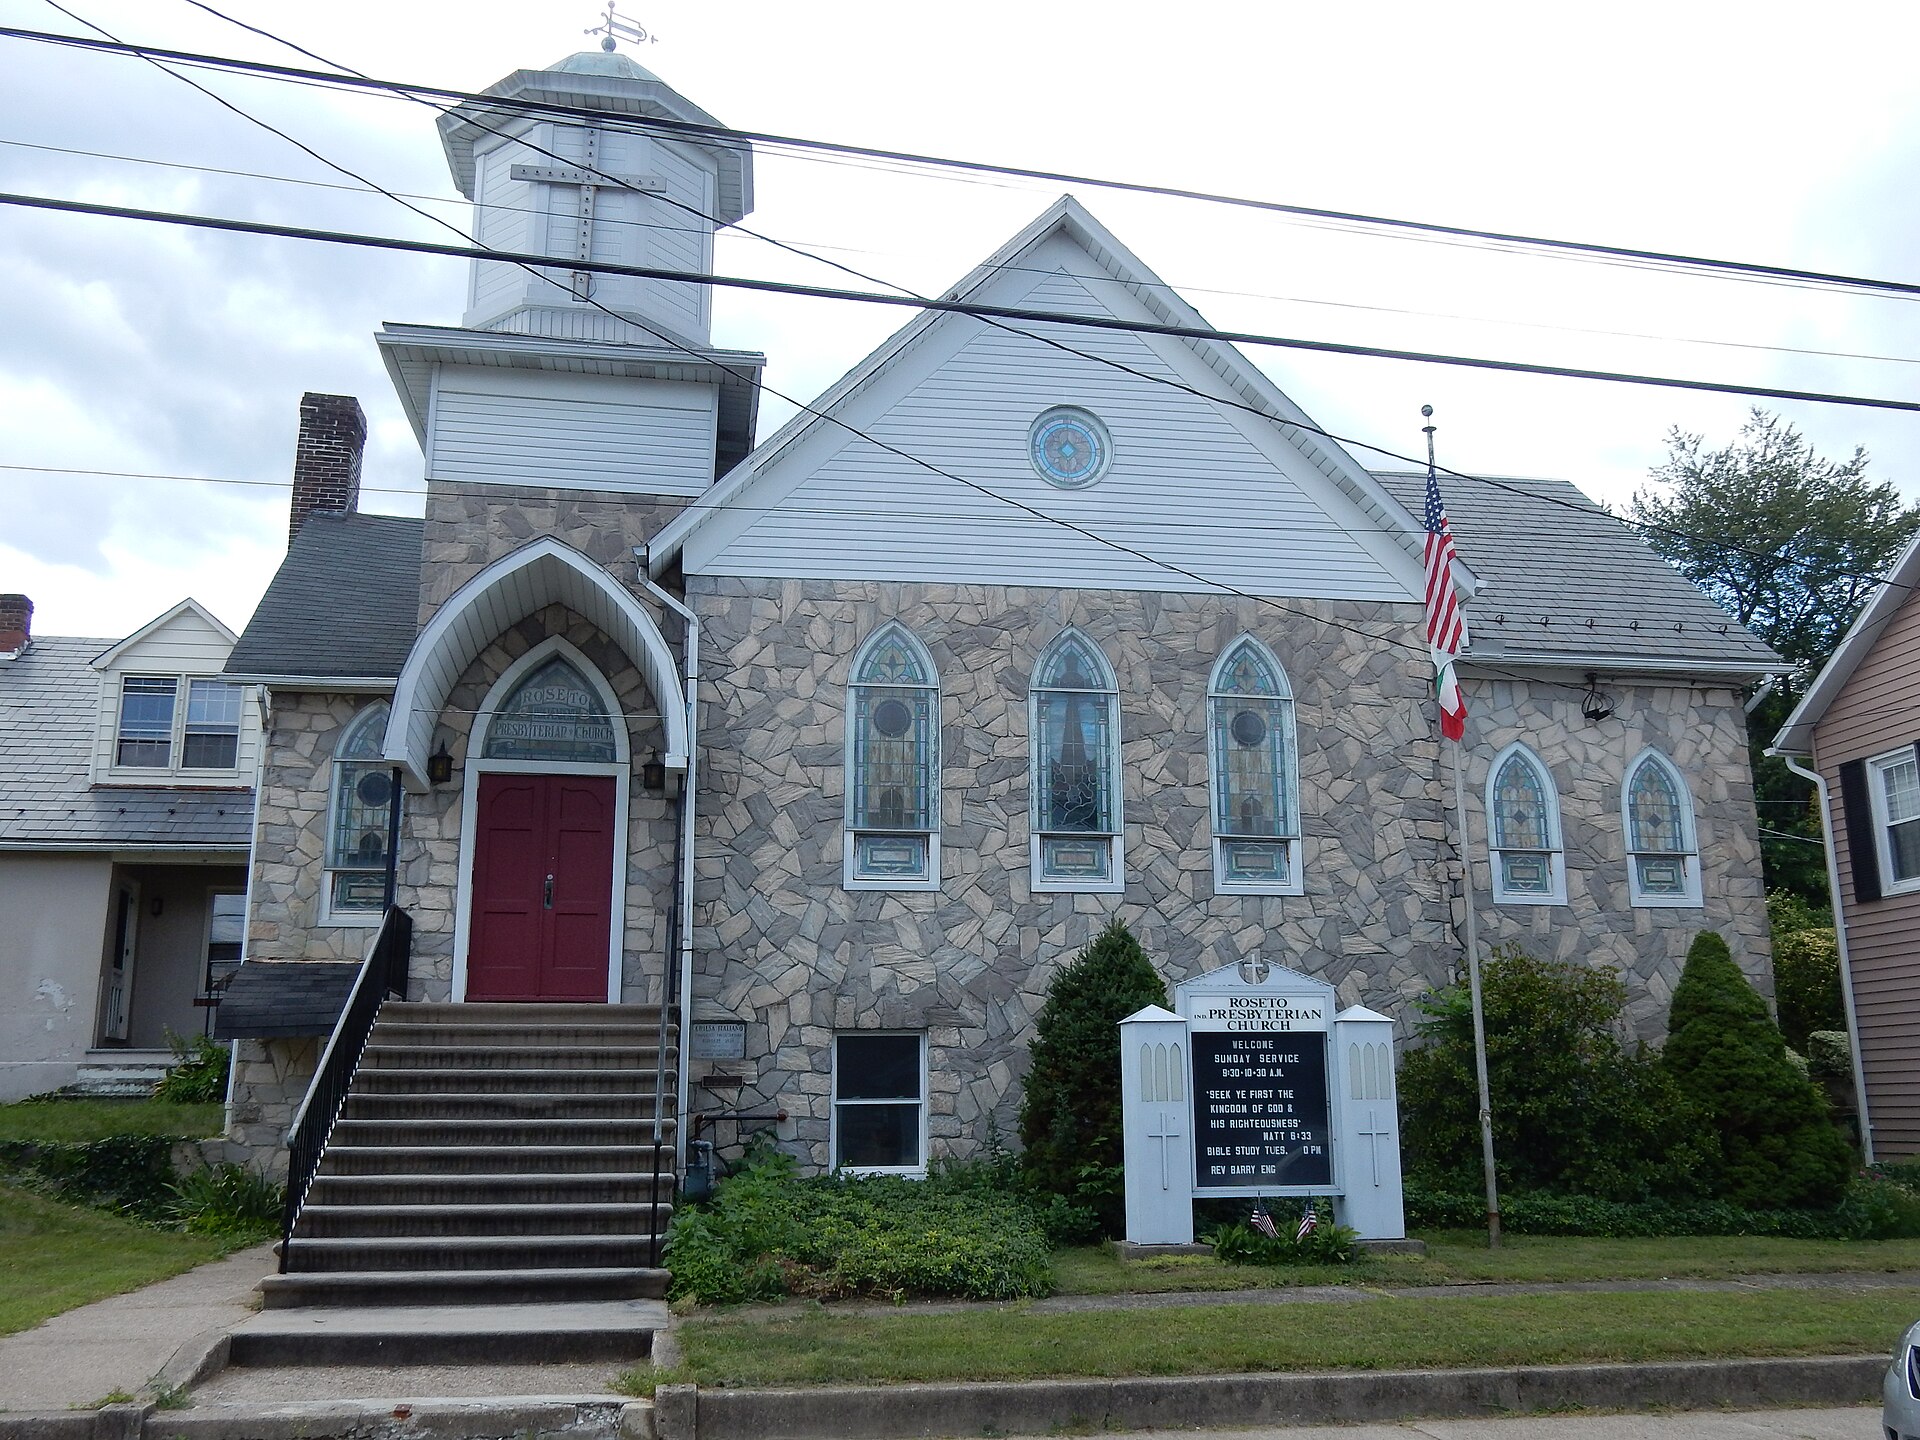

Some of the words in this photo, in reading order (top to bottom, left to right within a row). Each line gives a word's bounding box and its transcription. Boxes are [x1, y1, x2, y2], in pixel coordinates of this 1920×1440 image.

[522, 688, 588, 706] ROSETO
[1229, 998, 1288, 1008] ROSETO
[1209, 1009, 1322, 1019] PRESBYTERIAN
[1227, 1020, 1291, 1031] CHURCH
[1232, 1040, 1274, 1049] WELCOME
[1214, 1054, 1251, 1064] SUNDAY
[1259, 1054, 1300, 1063] SERVICE
[1235, 1090, 1246, 1099] YE
[1250, 1089, 1274, 1099] FIRST
[1277, 1089, 1294, 1099] THE
[1210, 1104, 1248, 1114] KINGDOM
[1252, 1104, 1263, 1113] OF
[1267, 1104, 1284, 1113] GOD
[1210, 1119, 1225, 1129] HIS
[1263, 1131, 1285, 1141] MATT
[1290, 1131, 1312, 1140] 6:33
[1206, 1146, 1231, 1156] BIBLE
[1235, 1146, 1261, 1156] STUDY
[1264, 1145, 1288, 1155] TUES.
[1310, 1145, 1322, 1155] PM
[1210, 1165, 1226, 1175] REV
[1230, 1165, 1256, 1175] BARRY
[1260, 1164, 1276, 1174] ENG
